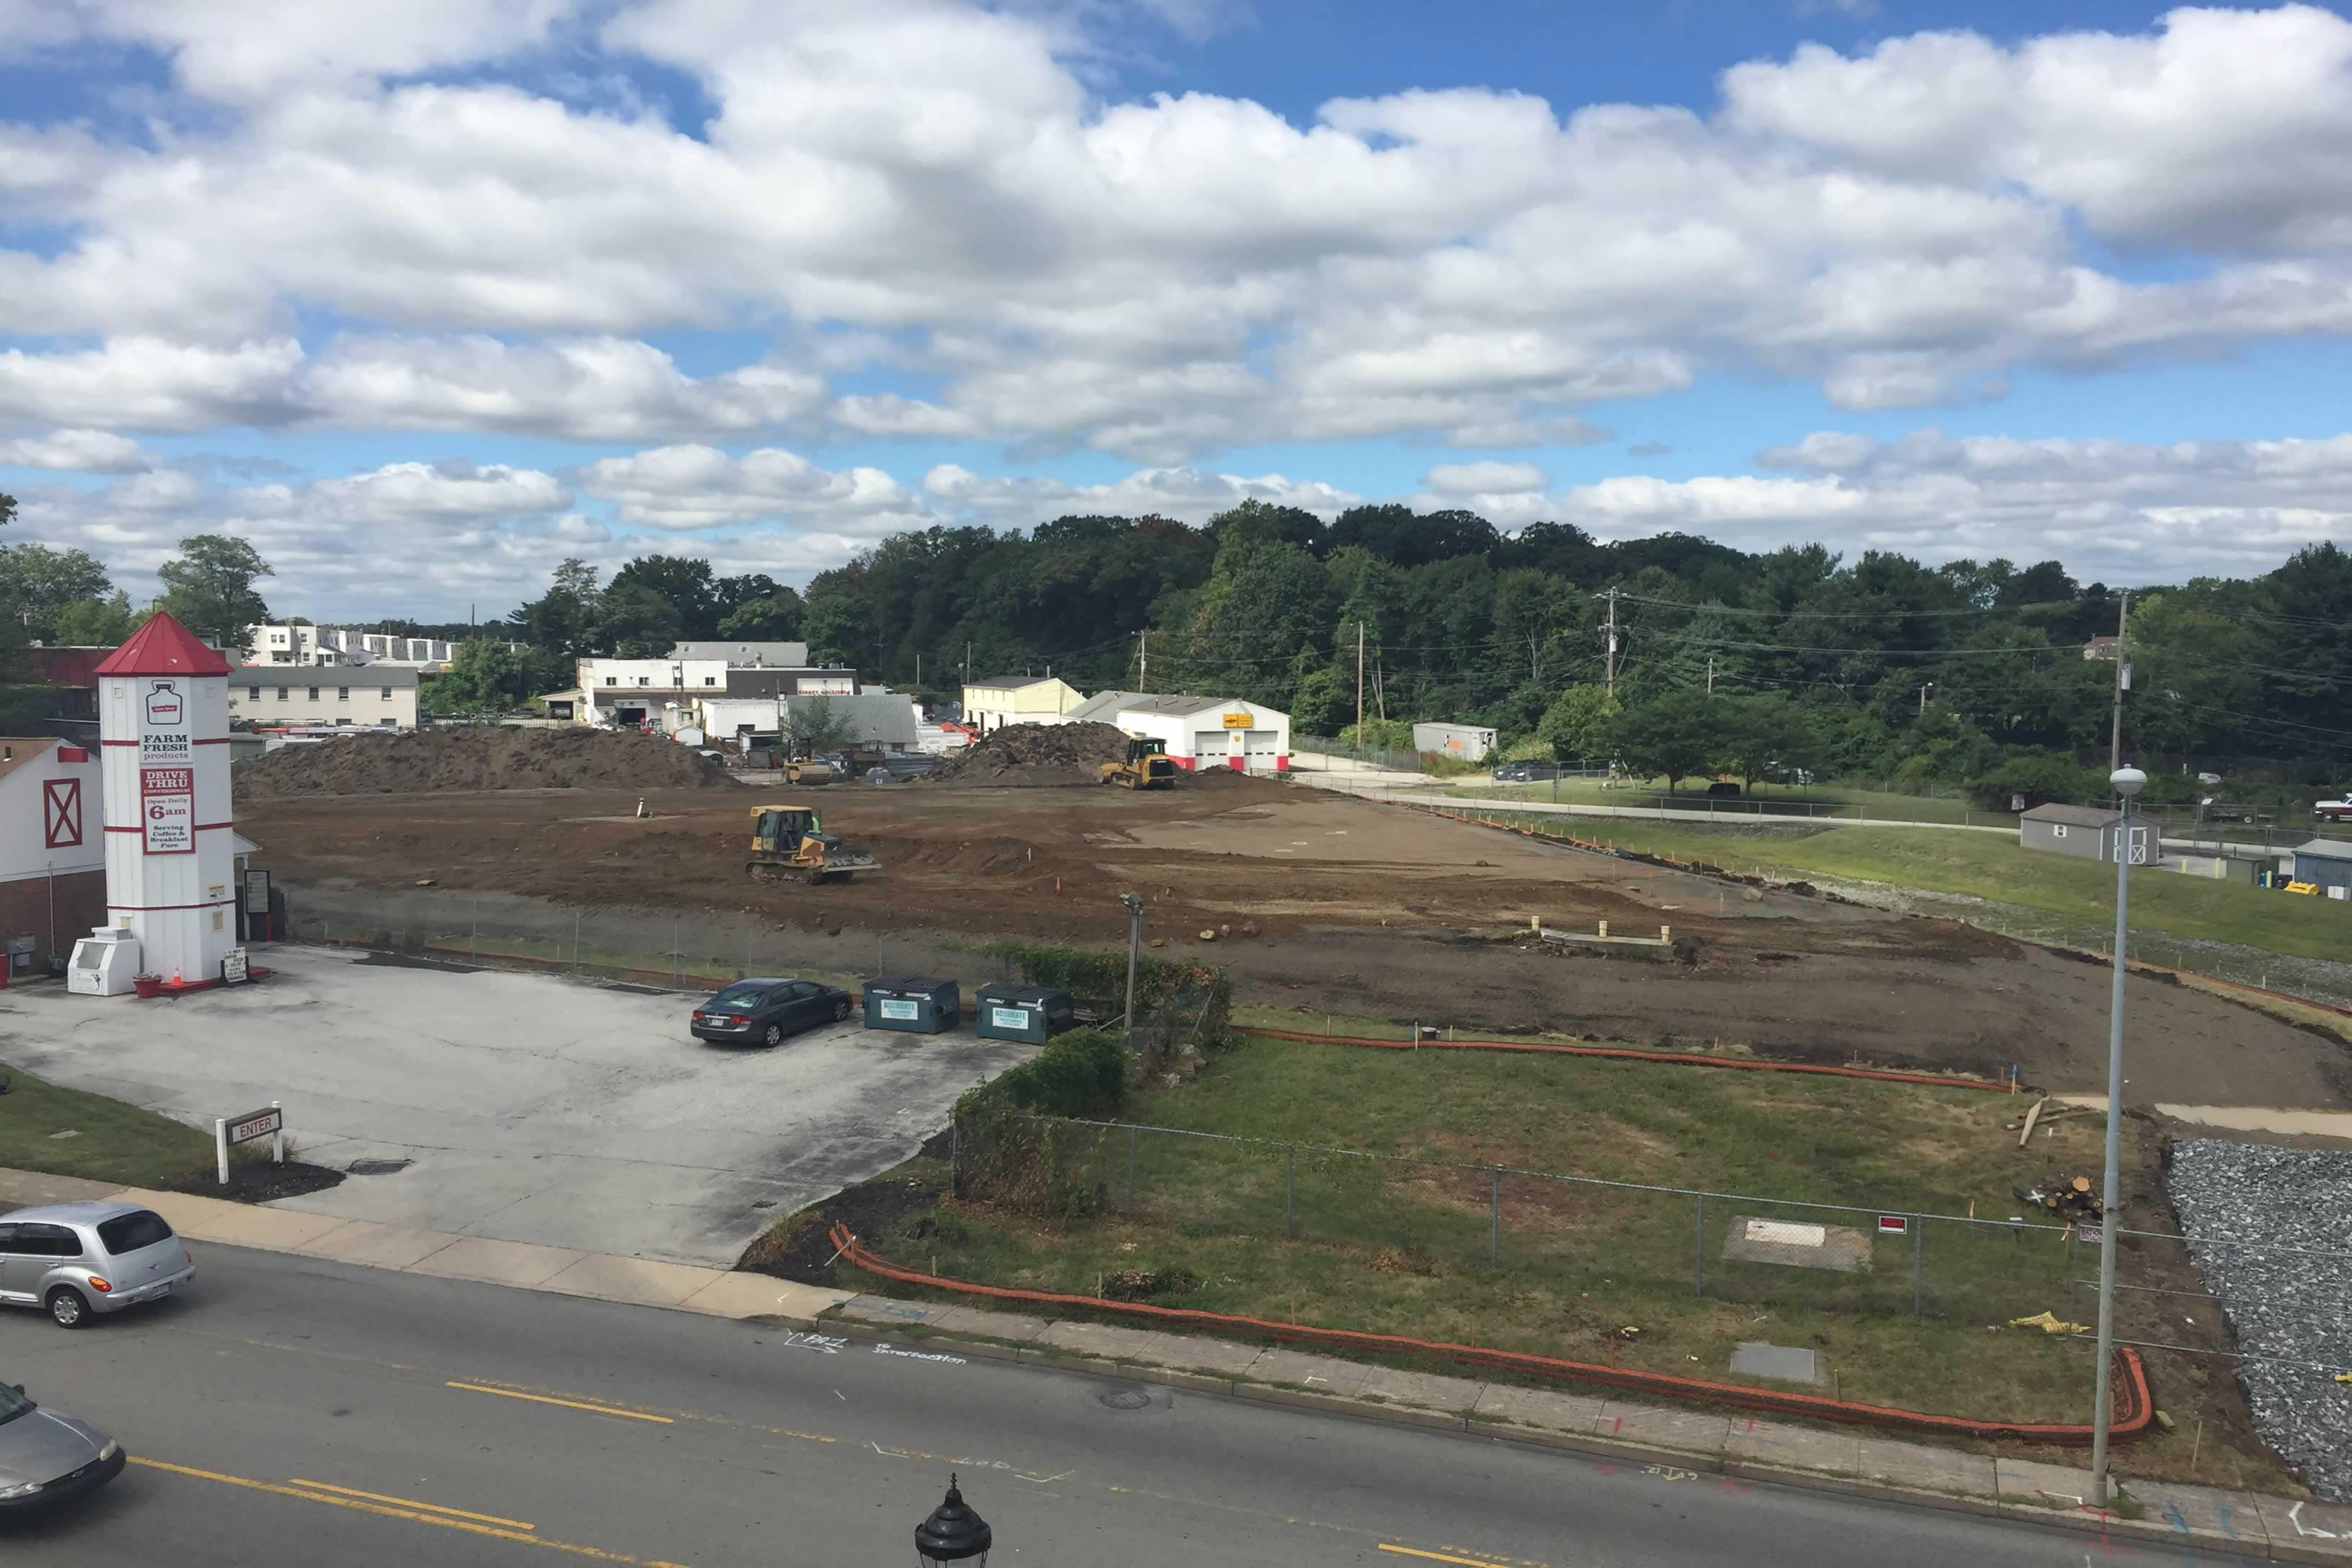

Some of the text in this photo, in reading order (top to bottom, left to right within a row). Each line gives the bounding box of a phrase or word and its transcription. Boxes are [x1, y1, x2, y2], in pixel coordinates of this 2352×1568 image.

[143, 734, 188, 743] FARM
[146, 771, 188, 779] DRIVE
[145, 779, 188, 788] THRU
[884, 1001, 915, 1010] ACCURATE
[995, 1010, 1026, 1020] ACCURATE
[240, 1117, 272, 1138] ENTER
